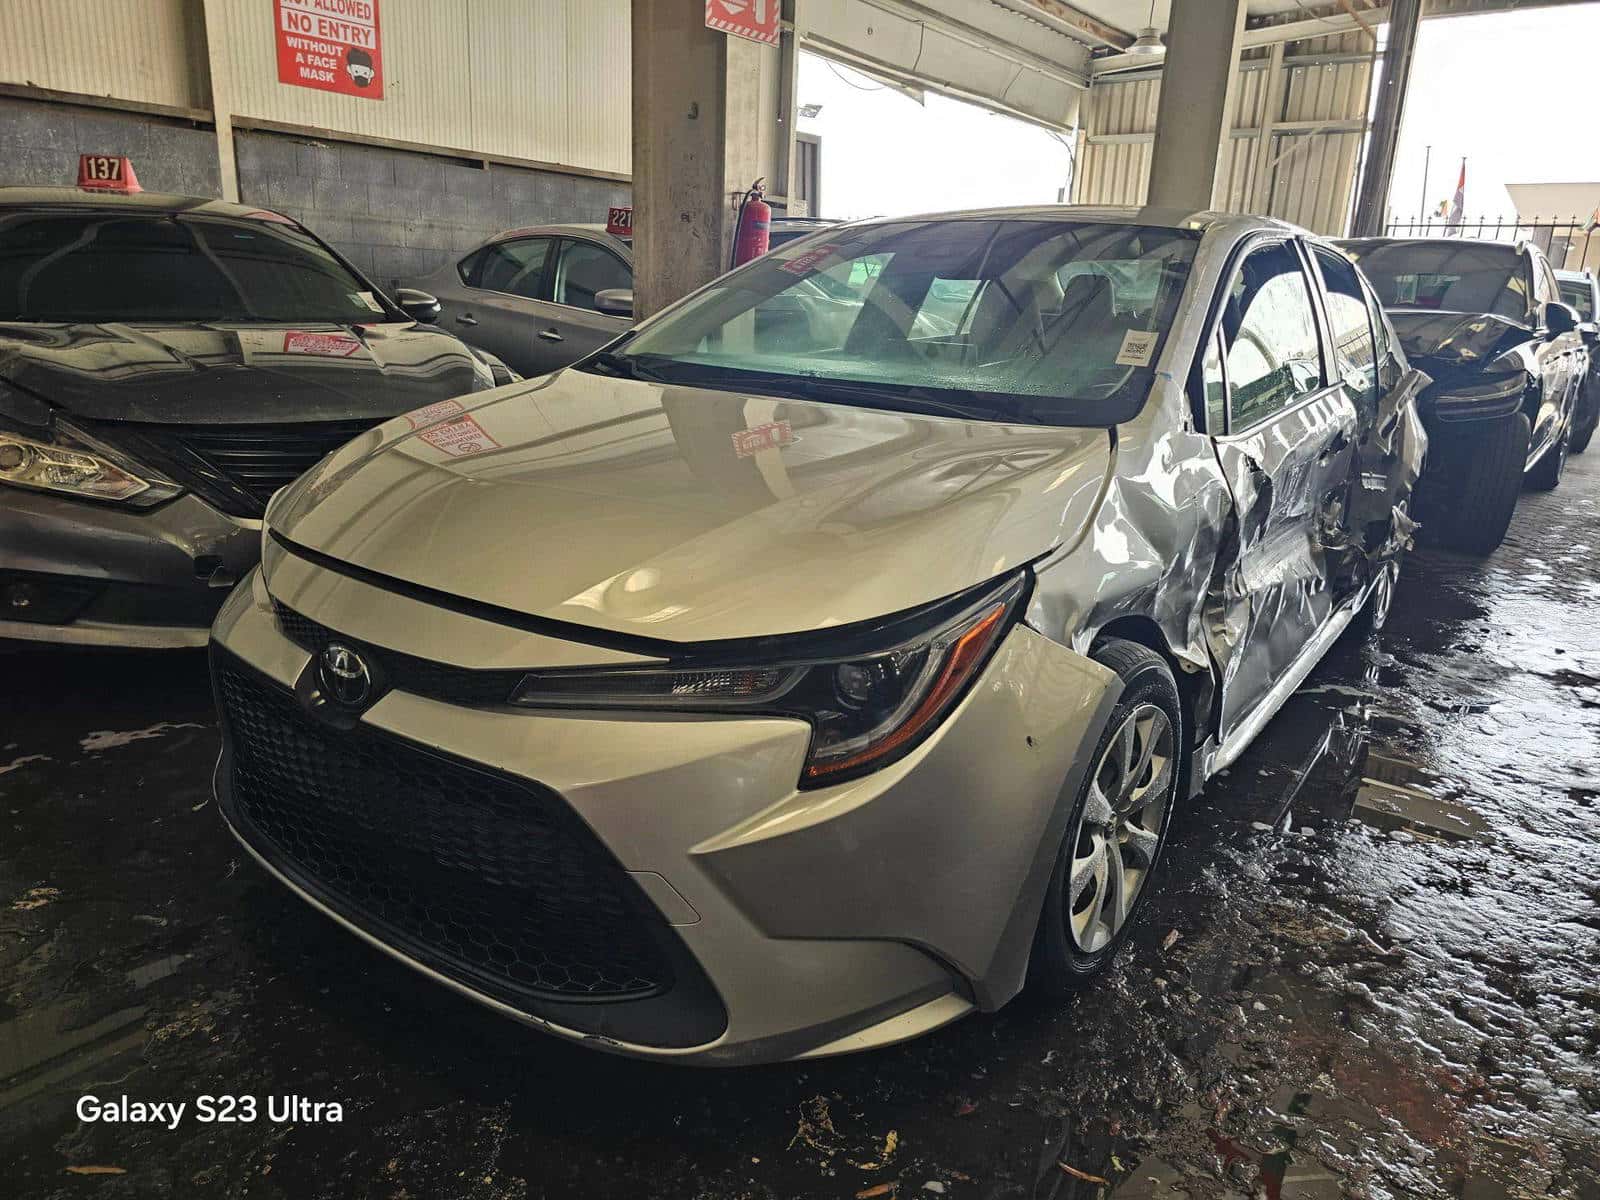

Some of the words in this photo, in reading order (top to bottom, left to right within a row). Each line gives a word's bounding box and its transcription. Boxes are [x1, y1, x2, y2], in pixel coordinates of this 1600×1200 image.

[287, 12, 312, 32] NO
[318, 18, 370, 45] ENTRY
[287, 36, 343, 56] WITHOUT
[296, 53, 305, 63] A
[307, 56, 337, 69] FACE
[300, 67, 335, 83] MASK
[88, 157, 119, 179] 137
[612, 210, 632, 228] 221
